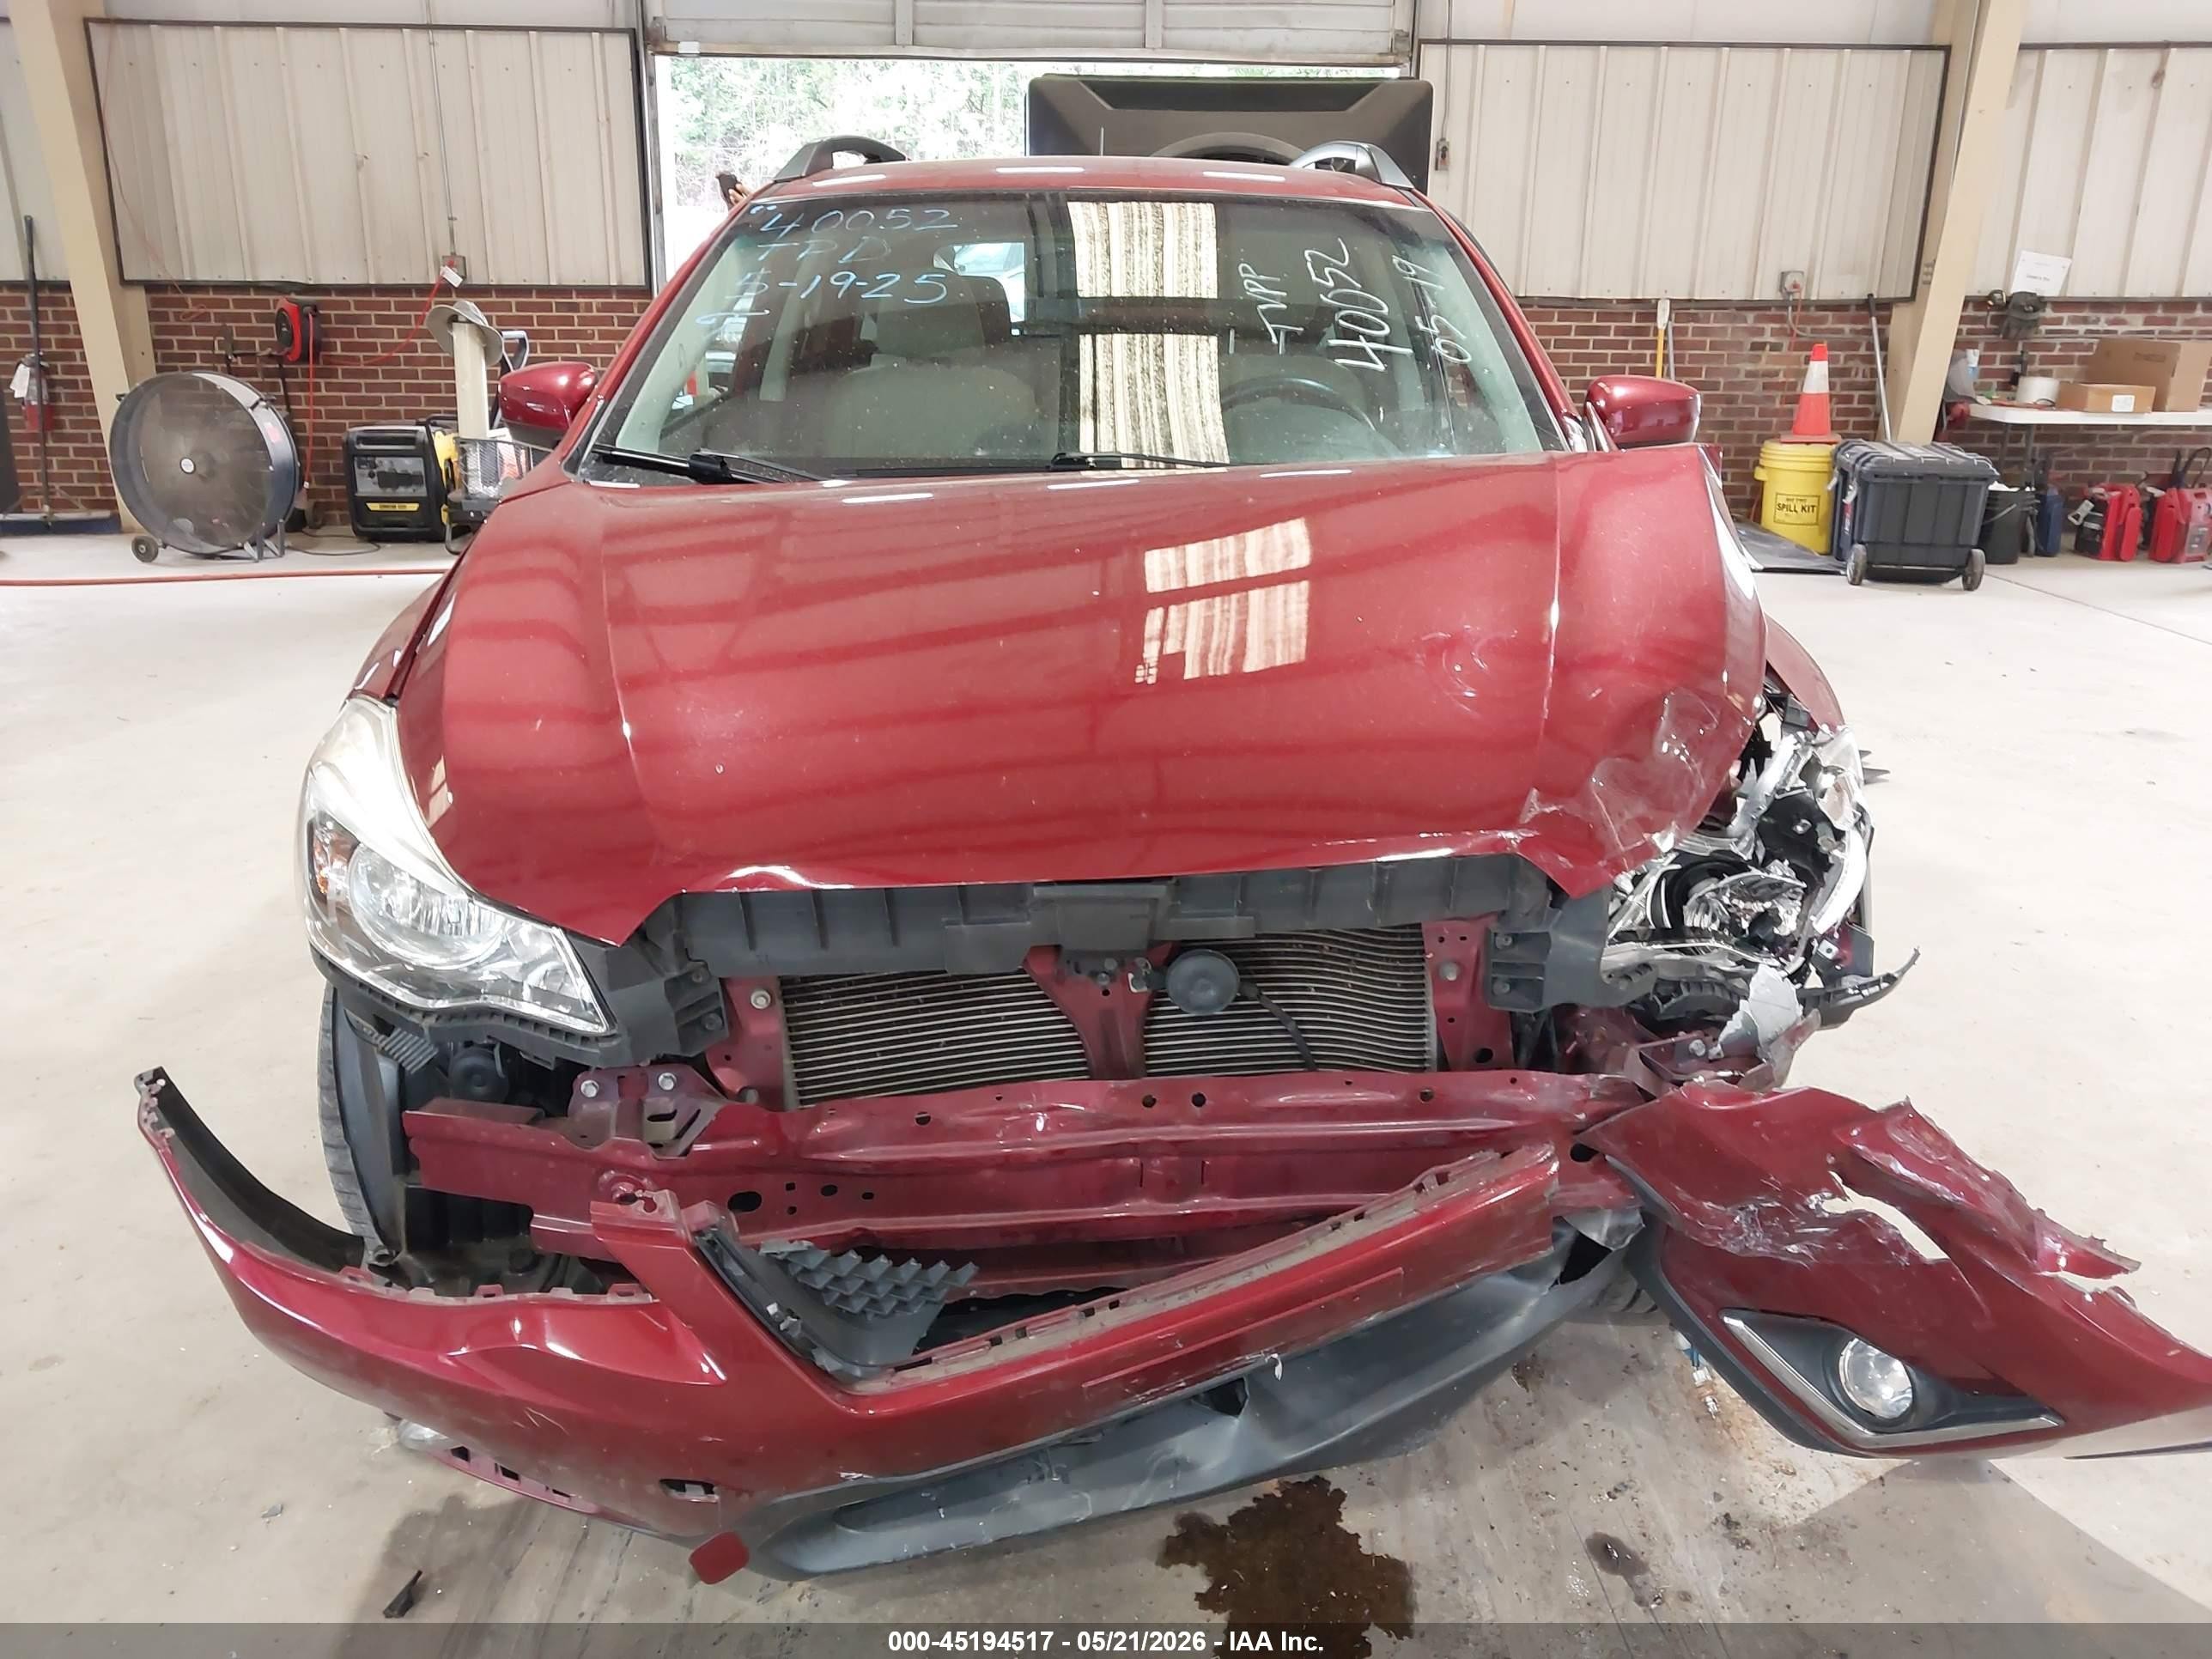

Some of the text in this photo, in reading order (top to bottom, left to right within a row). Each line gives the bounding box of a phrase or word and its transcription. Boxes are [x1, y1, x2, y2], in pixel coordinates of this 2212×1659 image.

[1303, 237, 1414, 372] 40052
[1777, 502, 1816, 514] SPILL KIT
